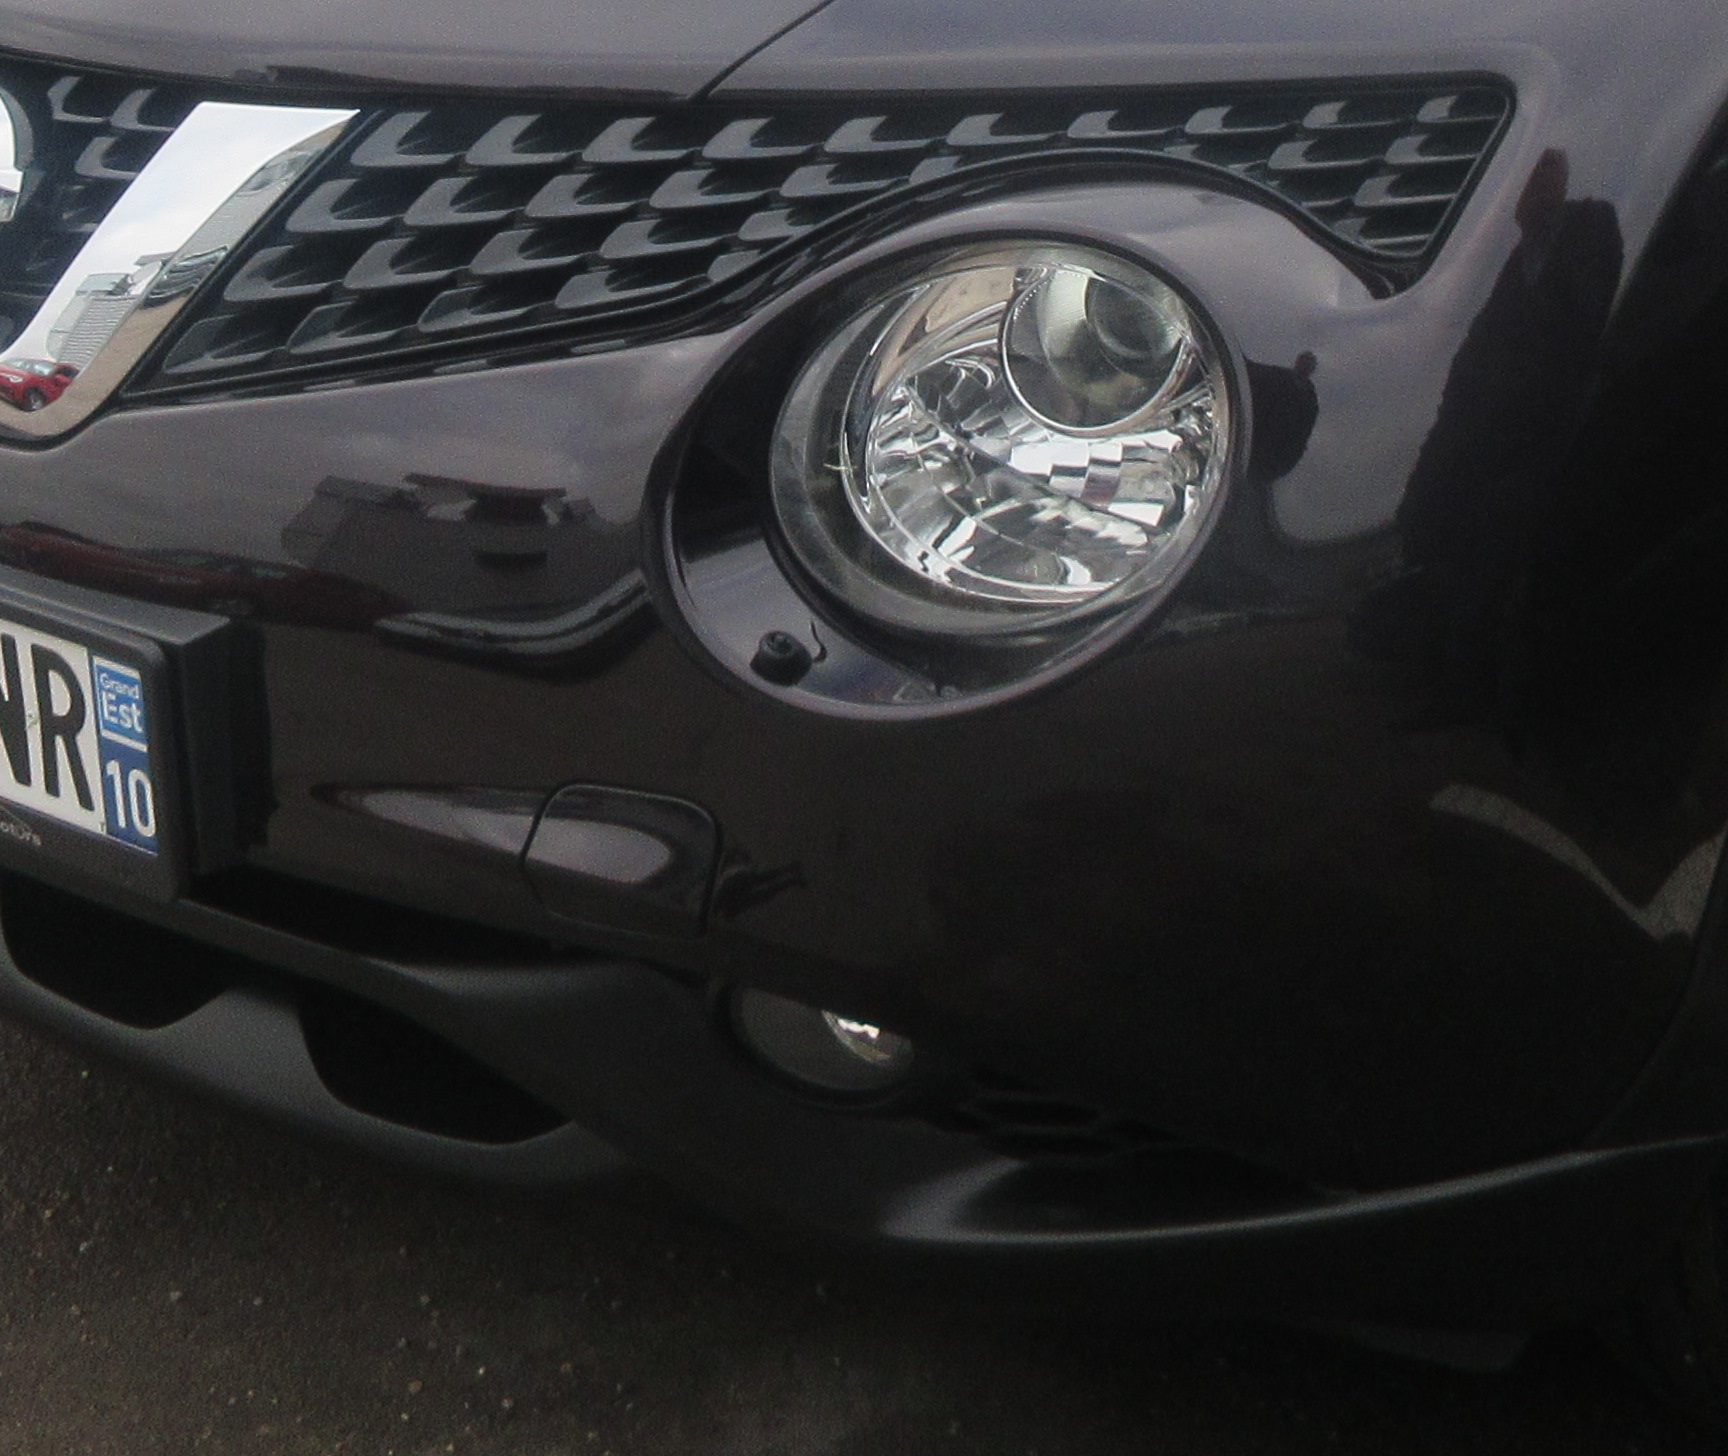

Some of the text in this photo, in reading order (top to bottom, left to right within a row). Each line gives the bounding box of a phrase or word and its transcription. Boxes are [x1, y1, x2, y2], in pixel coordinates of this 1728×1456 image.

[99, 672, 140, 699] Grand
[101, 691, 144, 733] Est
[106, 759, 157, 837] 10
